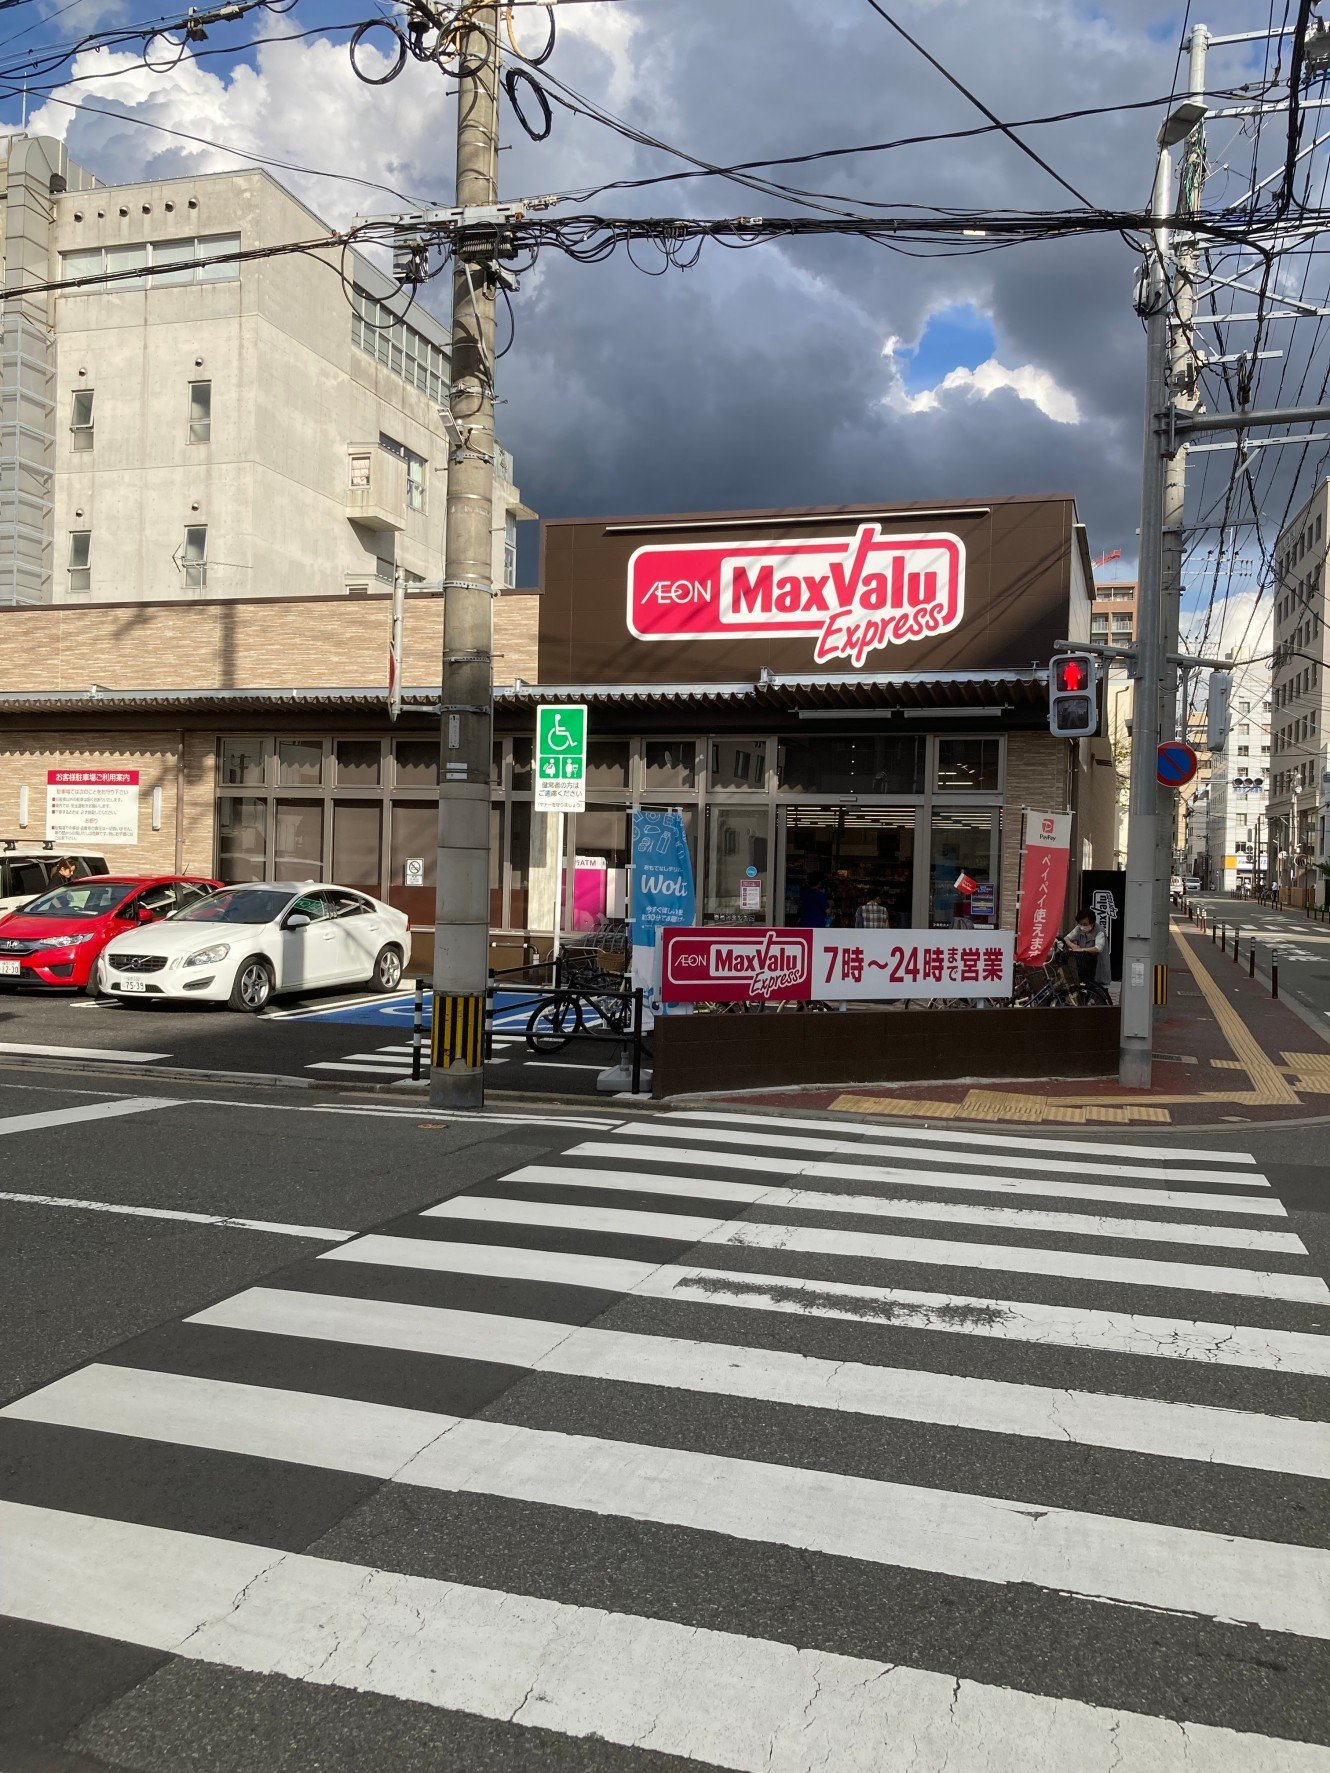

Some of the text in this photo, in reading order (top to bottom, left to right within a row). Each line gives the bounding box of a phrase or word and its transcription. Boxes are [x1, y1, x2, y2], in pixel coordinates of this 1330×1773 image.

[731, 528, 938, 615] MaxValu
[817, 601, 945, 663] Express
[55, 773, 131, 782] お客様駐車場ご利用案内
[538, 790, 583, 798] ご遠慮ください
[1039, 833, 1057, 842] PayPay
[641, 874, 688, 897] Wolt
[714, 933, 798, 973] MaxValu
[125, 981, 144, 990] 75-39
[750, 968, 800, 997] Express
